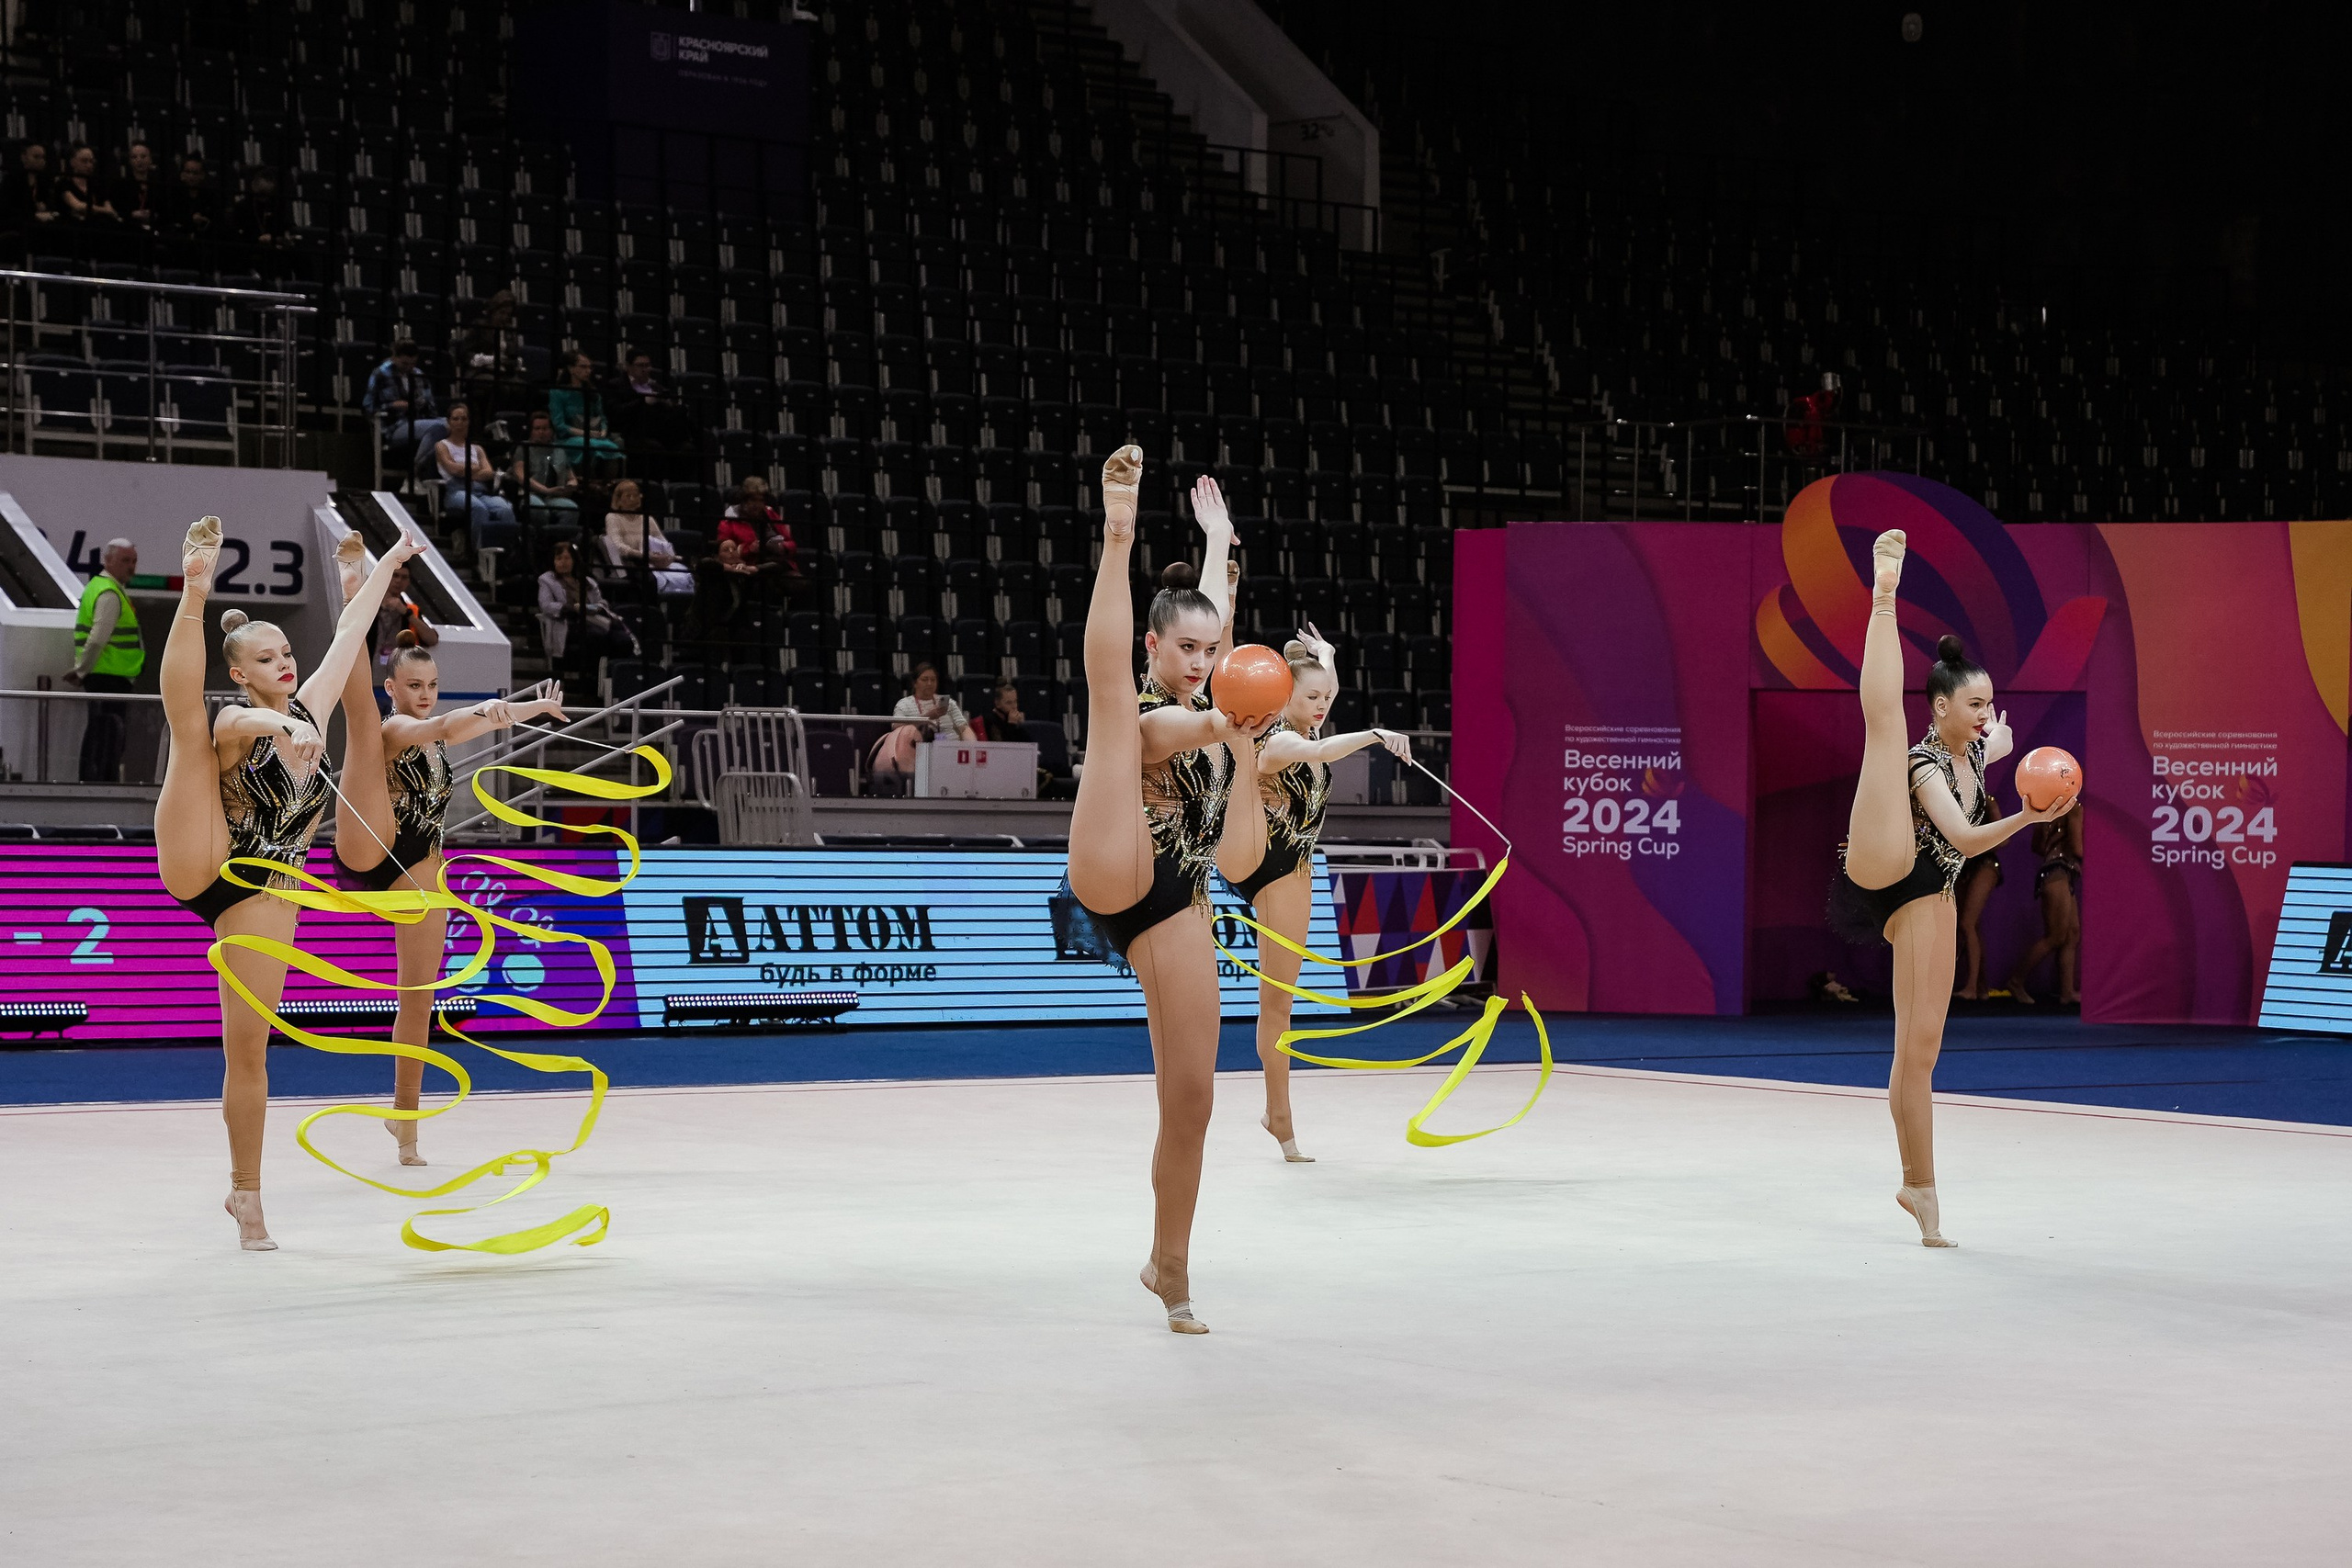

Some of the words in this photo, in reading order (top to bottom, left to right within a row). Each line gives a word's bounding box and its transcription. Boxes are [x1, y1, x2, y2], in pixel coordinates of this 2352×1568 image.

[678, 36, 769, 58] КРАСНОЯРСКИЙ
[678, 48, 709, 62] КРАЙ
[214, 537, 304, 595] 2.3
[1565, 750, 1681, 770] Весенний
[2153, 756, 2278, 776] Весенний
[1564, 772, 1632, 796] кубок
[2152, 779, 2225, 804] кубок
[1563, 797, 1681, 834] 2024
[2152, 806, 2278, 843] 2024
[1563, 836, 1632, 860] Spring
[1638, 837, 1679, 860] Cup
[2152, 845, 2225, 870] Spring
[2232, 846, 2277, 869] Cup
[67, 908, 115, 964] 2
[760, 962, 820, 988] будь
[830, 964, 843, 982] в
[853, 961, 936, 987] форме
